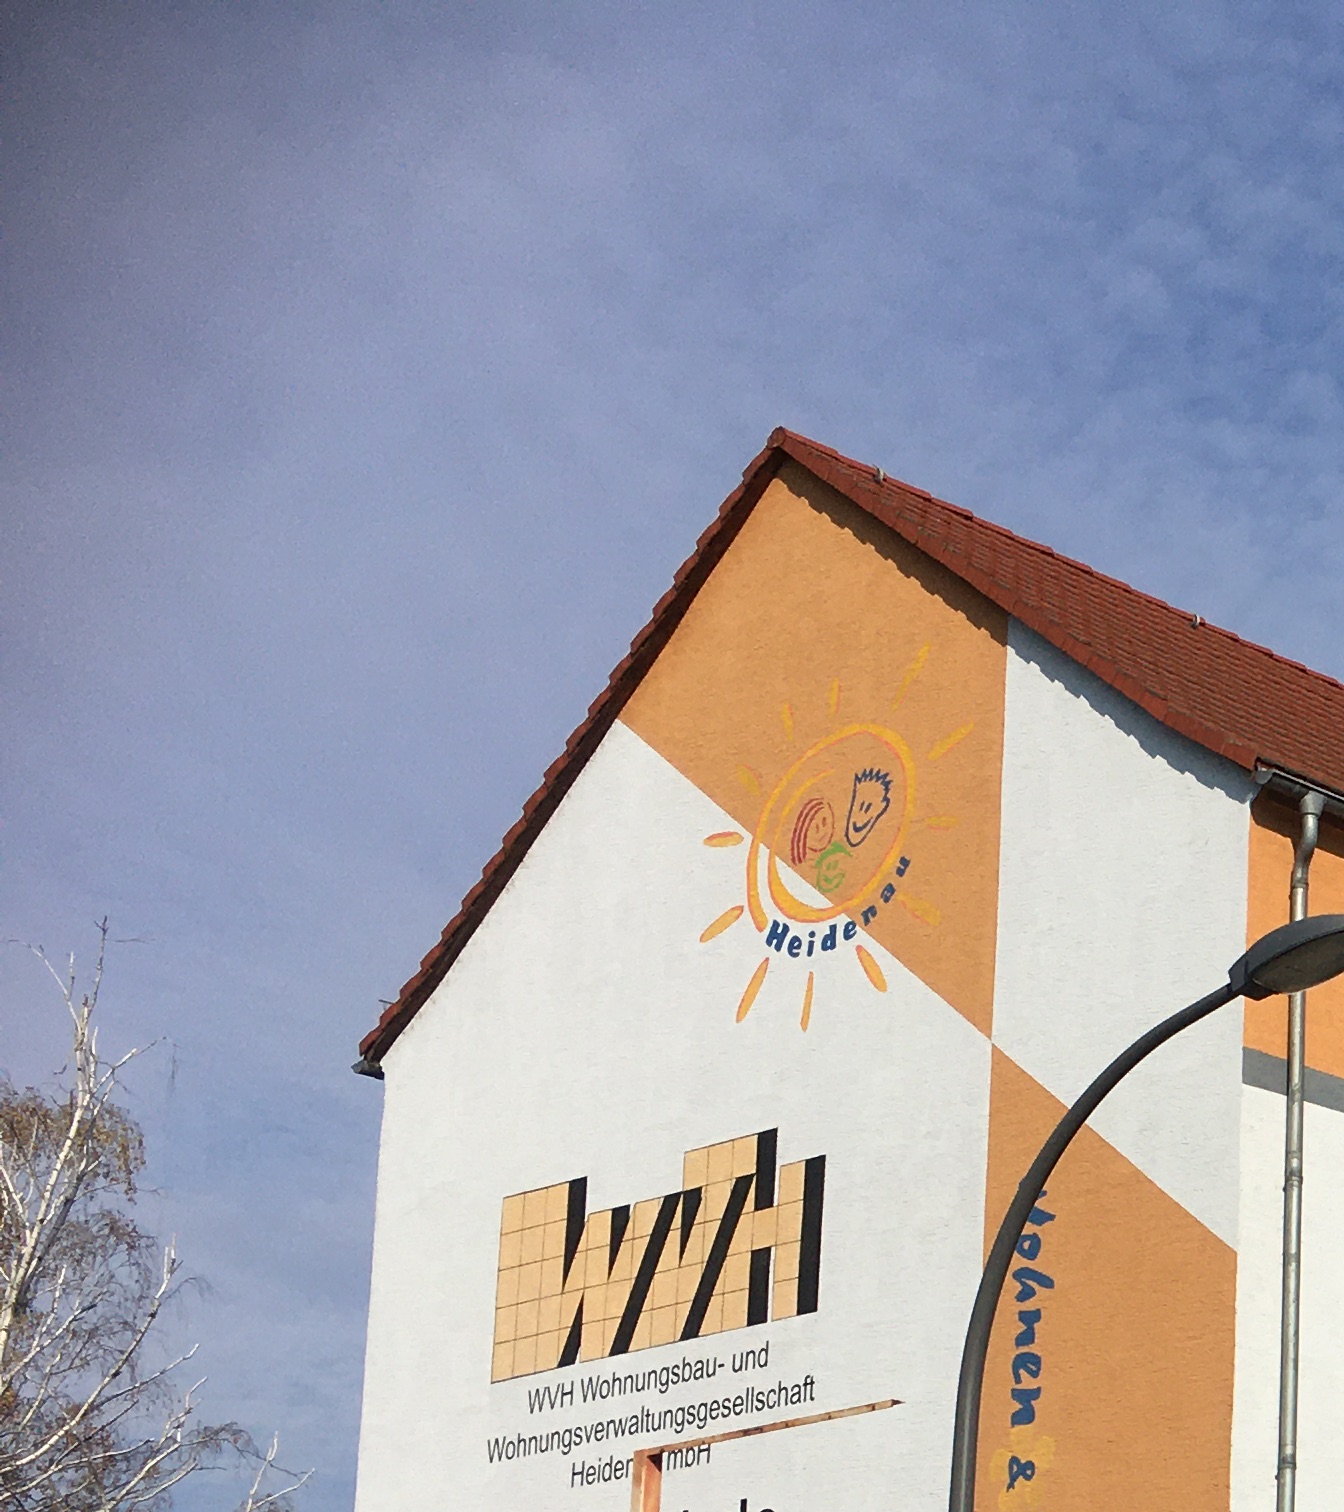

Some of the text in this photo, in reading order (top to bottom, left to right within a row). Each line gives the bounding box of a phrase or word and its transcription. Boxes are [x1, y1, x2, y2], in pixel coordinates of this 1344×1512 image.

[491, 1127, 826, 1384] WVH
[528, 1340, 770, 1415] WVH Wohnungsbau- und
[487, 1374, 815, 1464] Wohnungsverwaltungsgesellschaft
[1006, 1455, 1035, 1493] &
